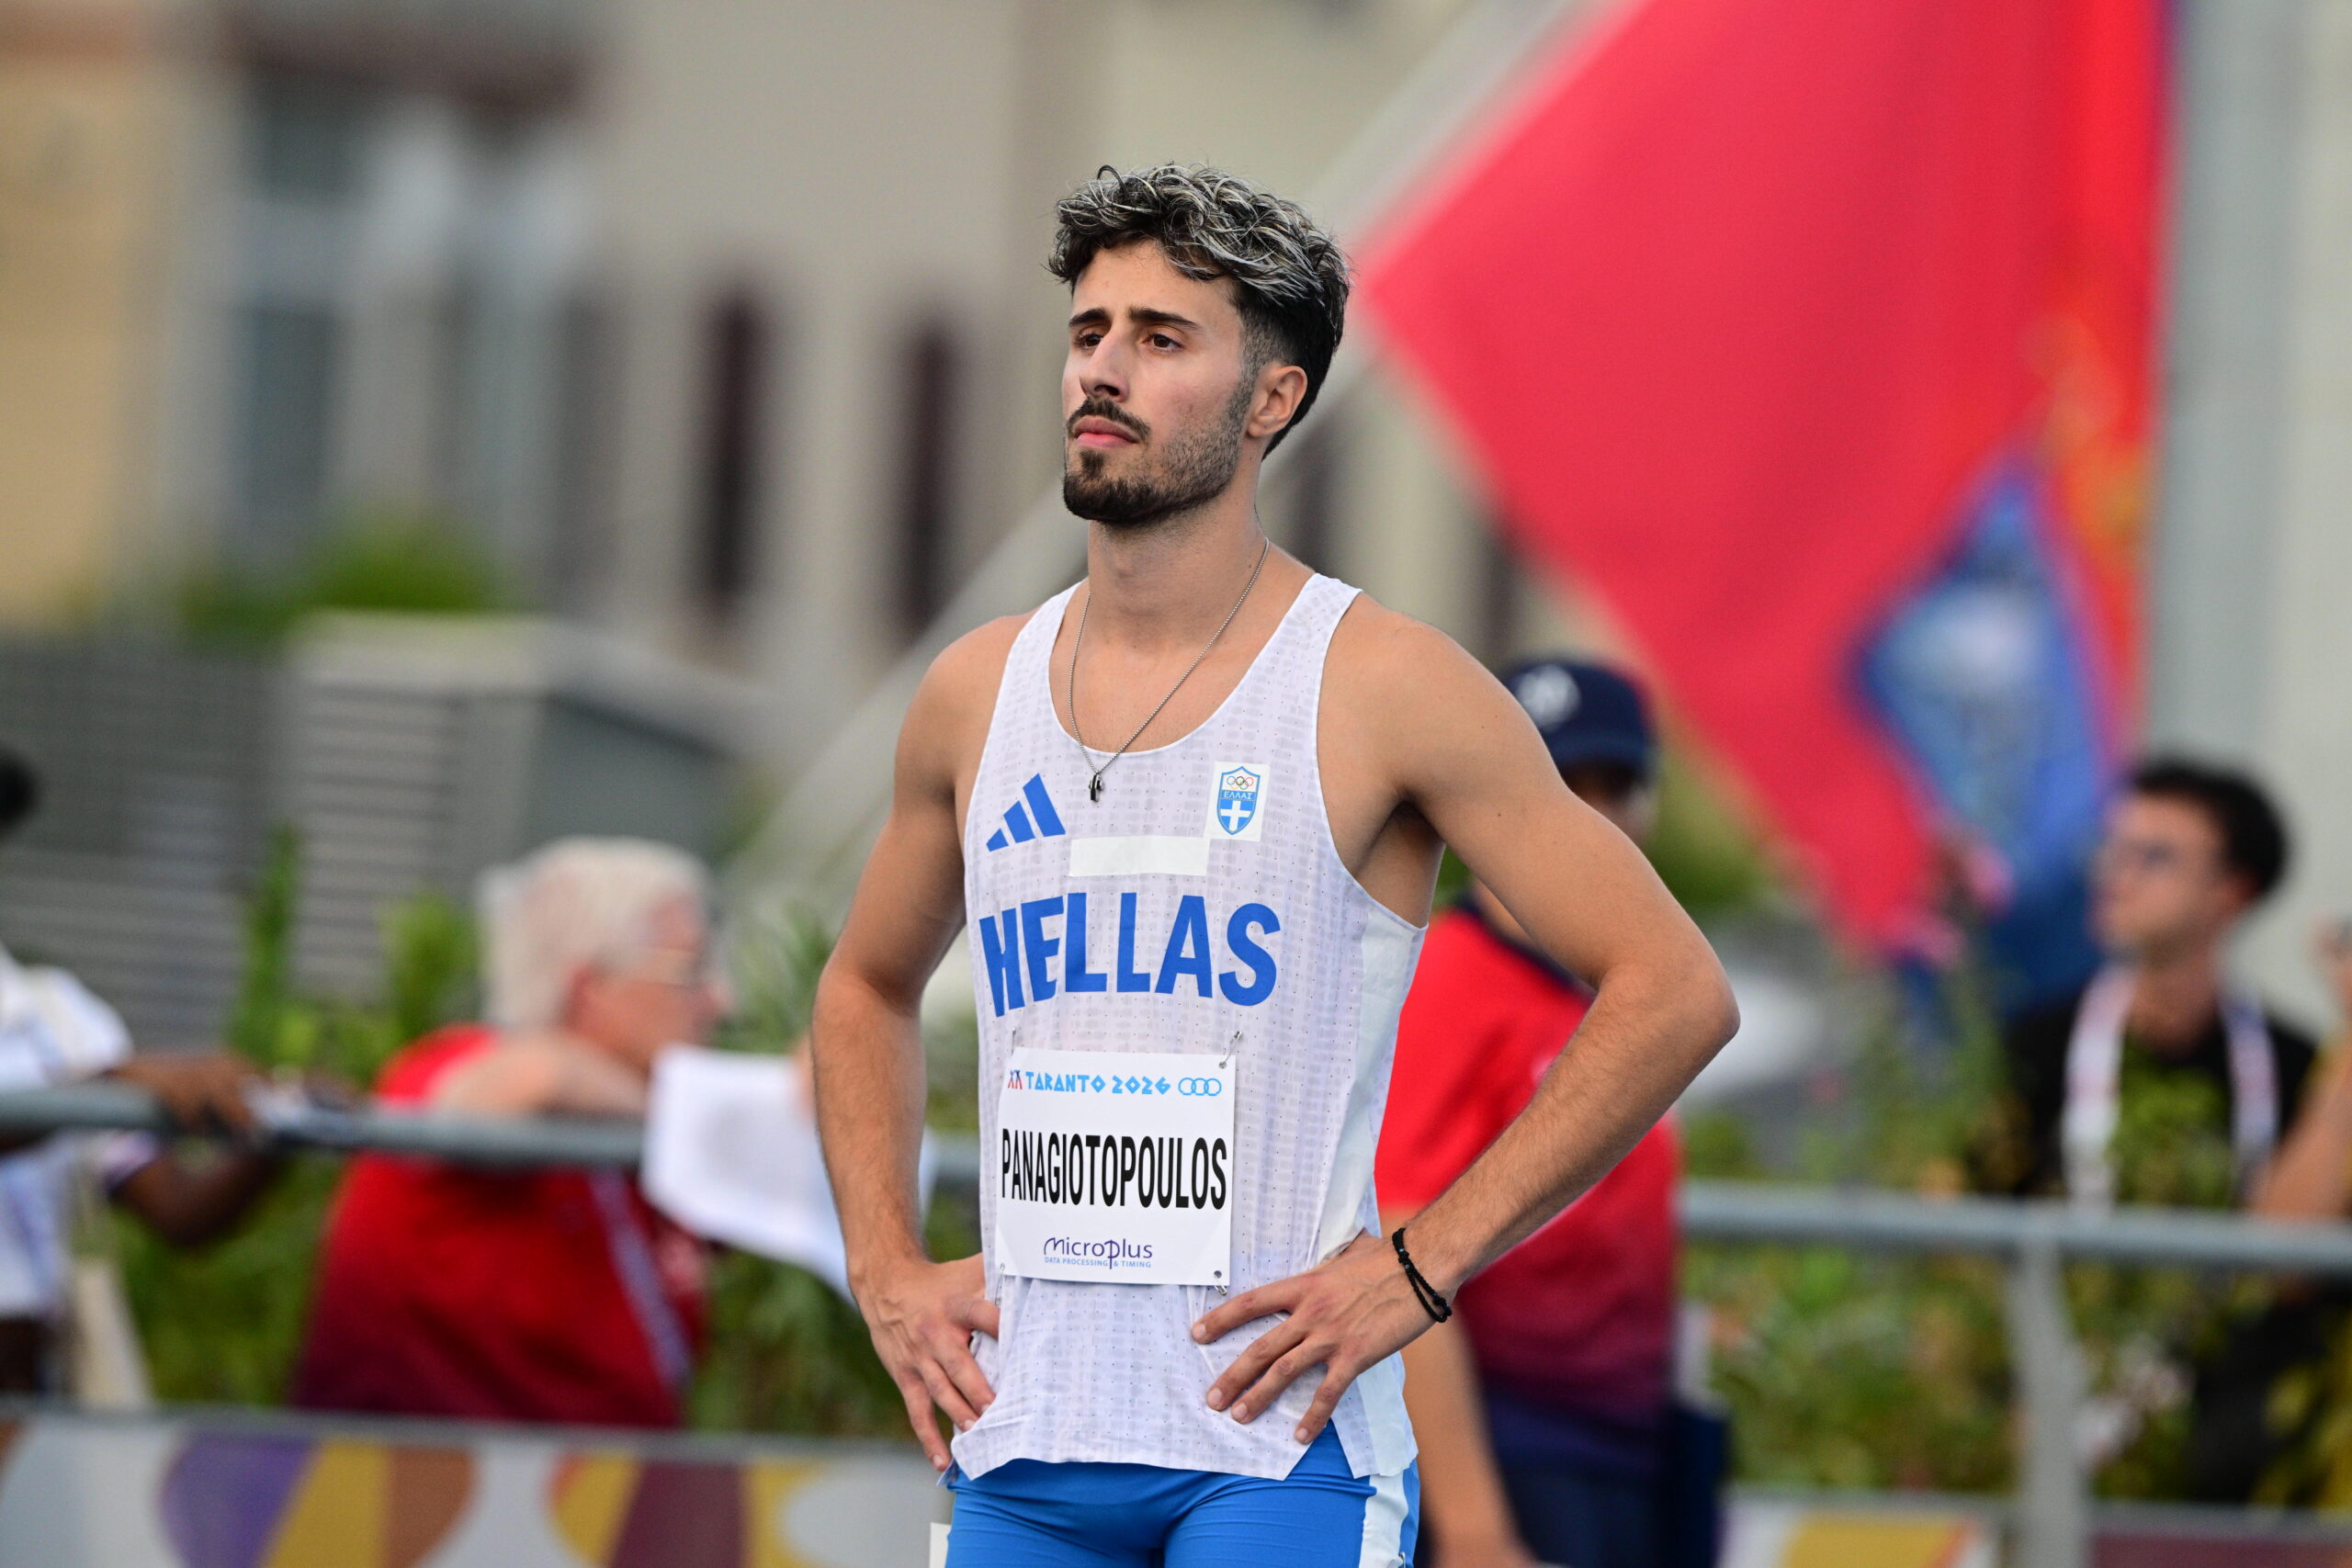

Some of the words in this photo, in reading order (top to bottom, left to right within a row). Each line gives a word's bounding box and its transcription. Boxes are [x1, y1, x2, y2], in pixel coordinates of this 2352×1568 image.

[1223, 791, 1253, 800] ΕΛΛΑΣ
[978, 891, 1281, 1018] HELLAS
[1025, 1071, 1106, 1093] TARANTO
[1112, 1075, 1171, 1095] 2026
[1002, 1128, 1227, 1210] PANAGIOTOPOULOS
[1045, 1256, 1060, 1264] DATA
[1062, 1258, 1108, 1267] PROCESSING
[1122, 1260, 1151, 1269] TIMING
